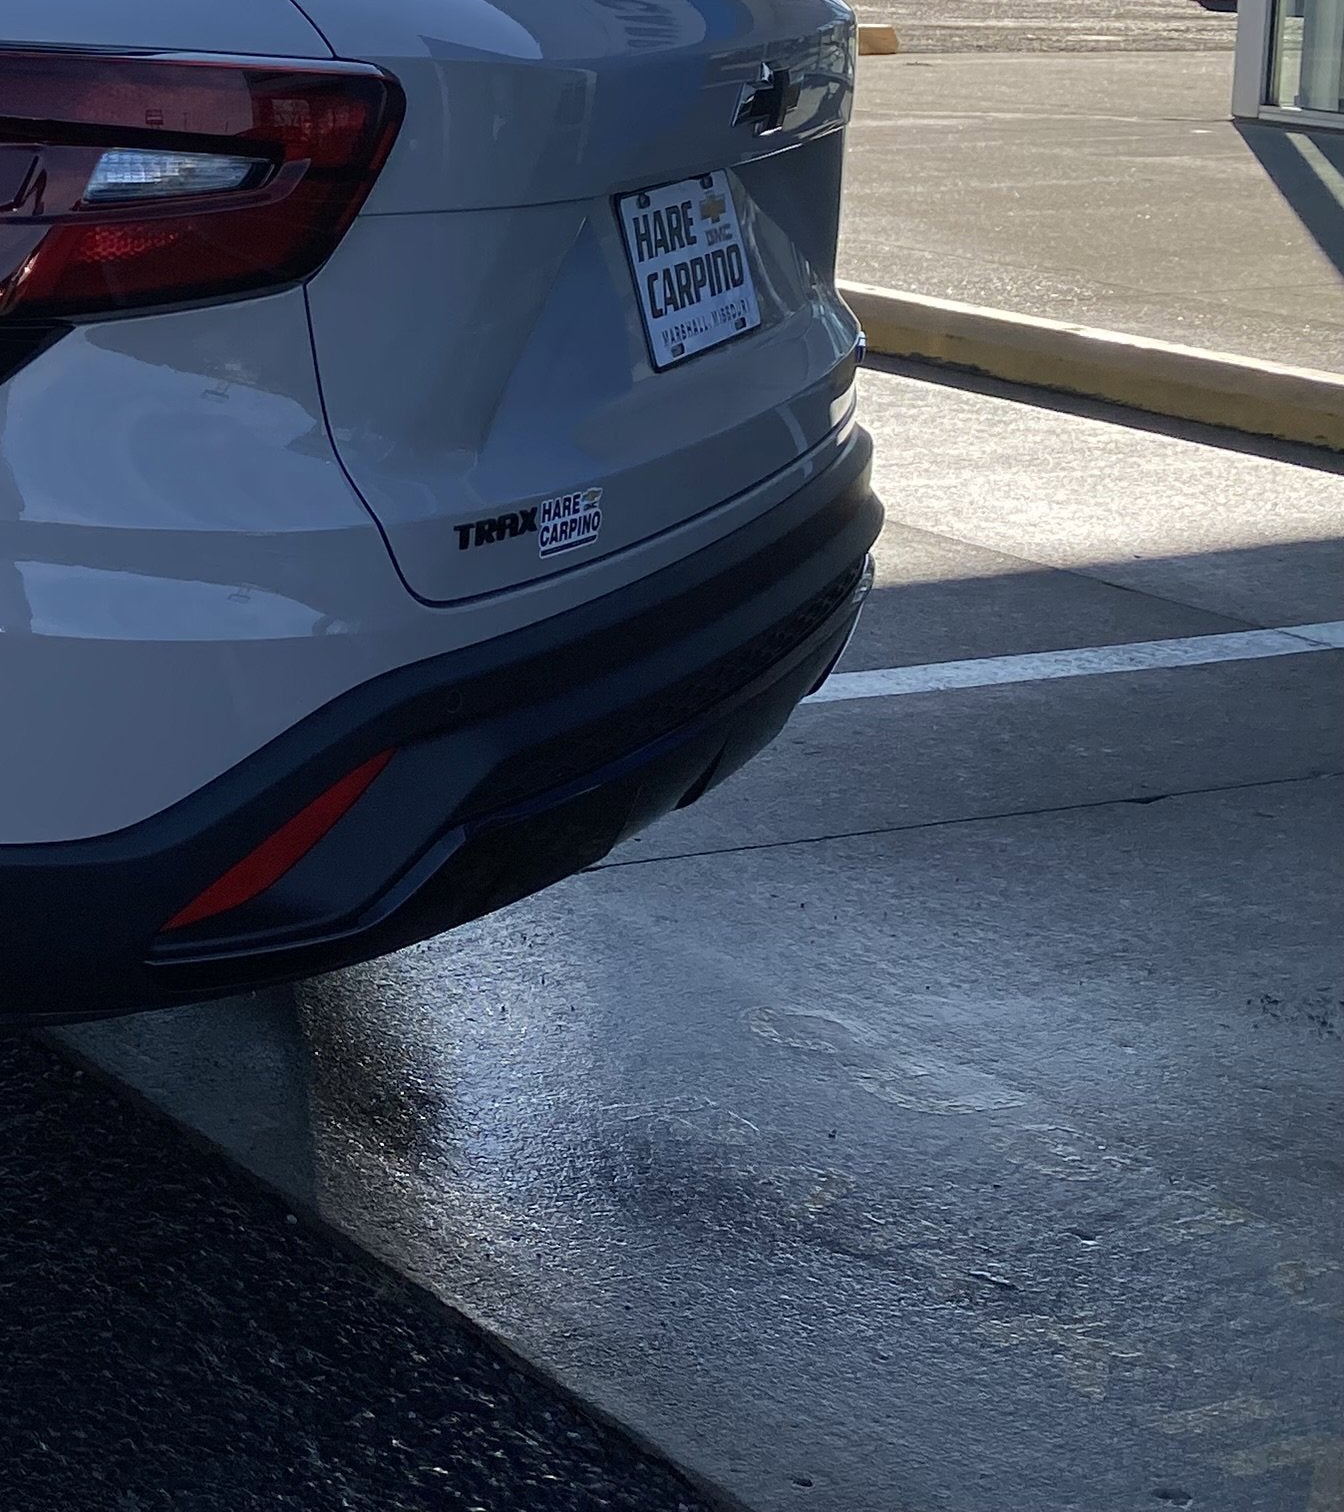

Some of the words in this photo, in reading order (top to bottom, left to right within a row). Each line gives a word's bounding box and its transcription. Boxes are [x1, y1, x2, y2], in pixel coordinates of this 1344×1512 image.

[633, 201, 697, 262] HARE
[646, 243, 744, 319] CARPINO
[453, 507, 538, 550] TRAX
[540, 511, 601, 548] CARPINO
[542, 494, 581, 523] HARE
